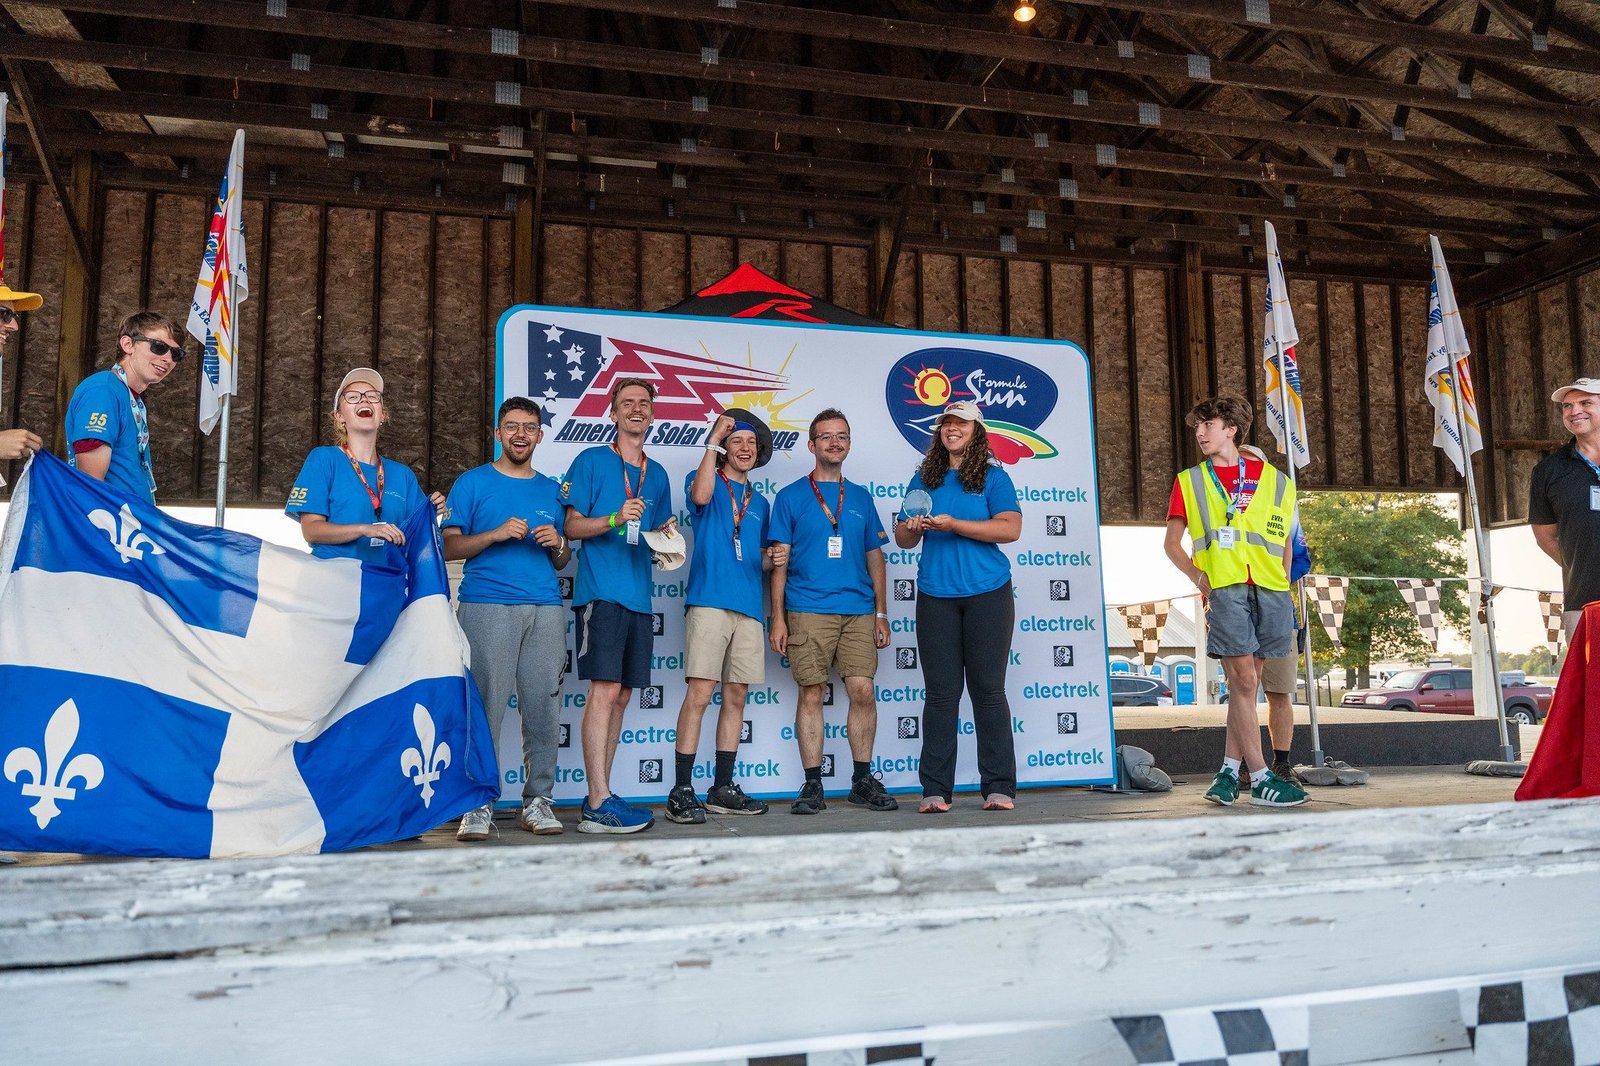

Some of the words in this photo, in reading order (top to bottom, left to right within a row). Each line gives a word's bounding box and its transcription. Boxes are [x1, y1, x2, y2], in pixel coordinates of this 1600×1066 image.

[965, 368, 1027, 409] Sun
[978, 373, 1028, 390] Formula
[88, 412, 108, 427] 55
[652, 421, 708, 446] Solar
[289, 486, 309, 500] 55
[1015, 485, 1088, 503] electrek
[1016, 550, 1092, 566] electrek
[1019, 615, 1096, 632] electrek
[1023, 681, 1100, 699] electrek
[869, 755, 920, 773] electr
[1027, 748, 1104, 768] electrek
